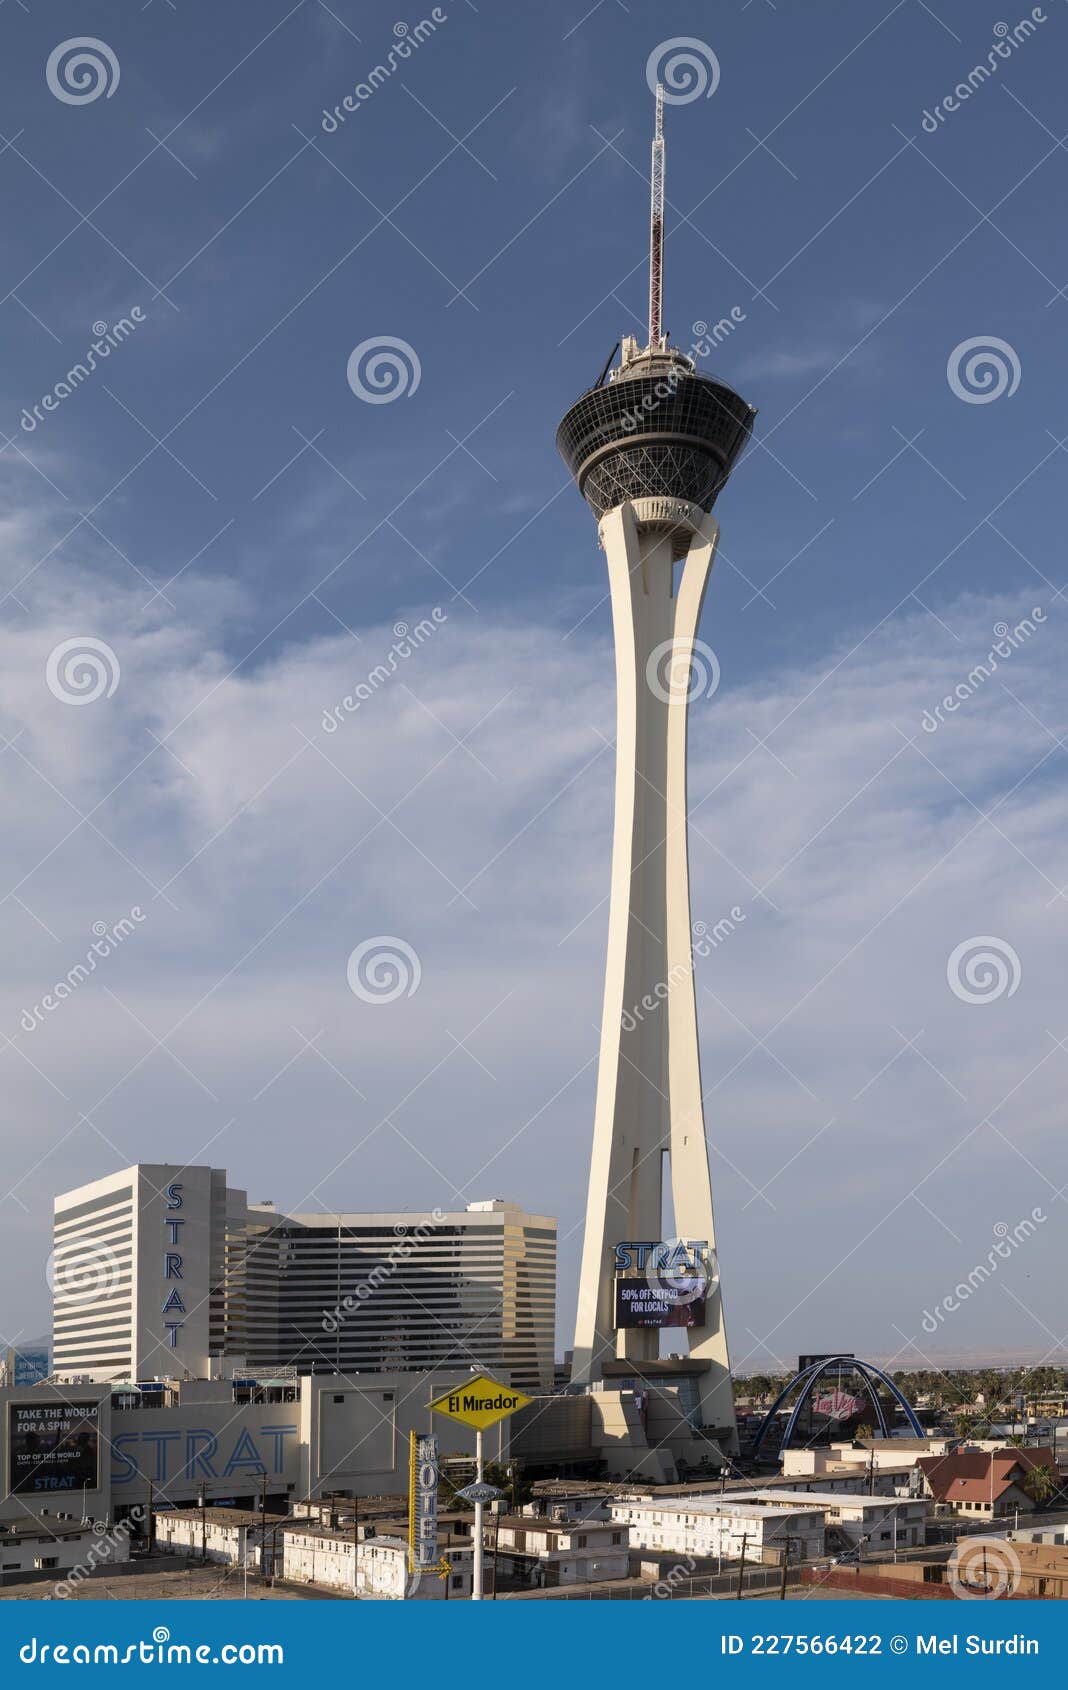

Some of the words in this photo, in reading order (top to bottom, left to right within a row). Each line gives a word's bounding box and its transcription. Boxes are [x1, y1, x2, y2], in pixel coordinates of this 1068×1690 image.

[615, 1239, 708, 1271] STRAT
[161, 1184, 187, 1348] STRAT
[621, 1289, 638, 1300] 50%
[639, 1289, 651, 1300] OFF
[630, 1302, 644, 1313] FOR
[644, 1301, 668, 1312] LOCALS
[449, 1397, 459, 1412] El
[463, 1394, 519, 1410] Mirador
[17, 1409, 42, 1419] TAKE
[44, 1408, 63, 1419] THE
[64, 1407, 98, 1418] WORLD
[17, 1422, 37, 1433] FOR
[38, 1421, 46, 1432] A
[47, 1421, 70, 1430] SPIN
[111, 1425, 297, 1484] STRAT
[34, 1476, 75, 1489] STRAT
[419, 1439, 436, 1564] MOTEL
